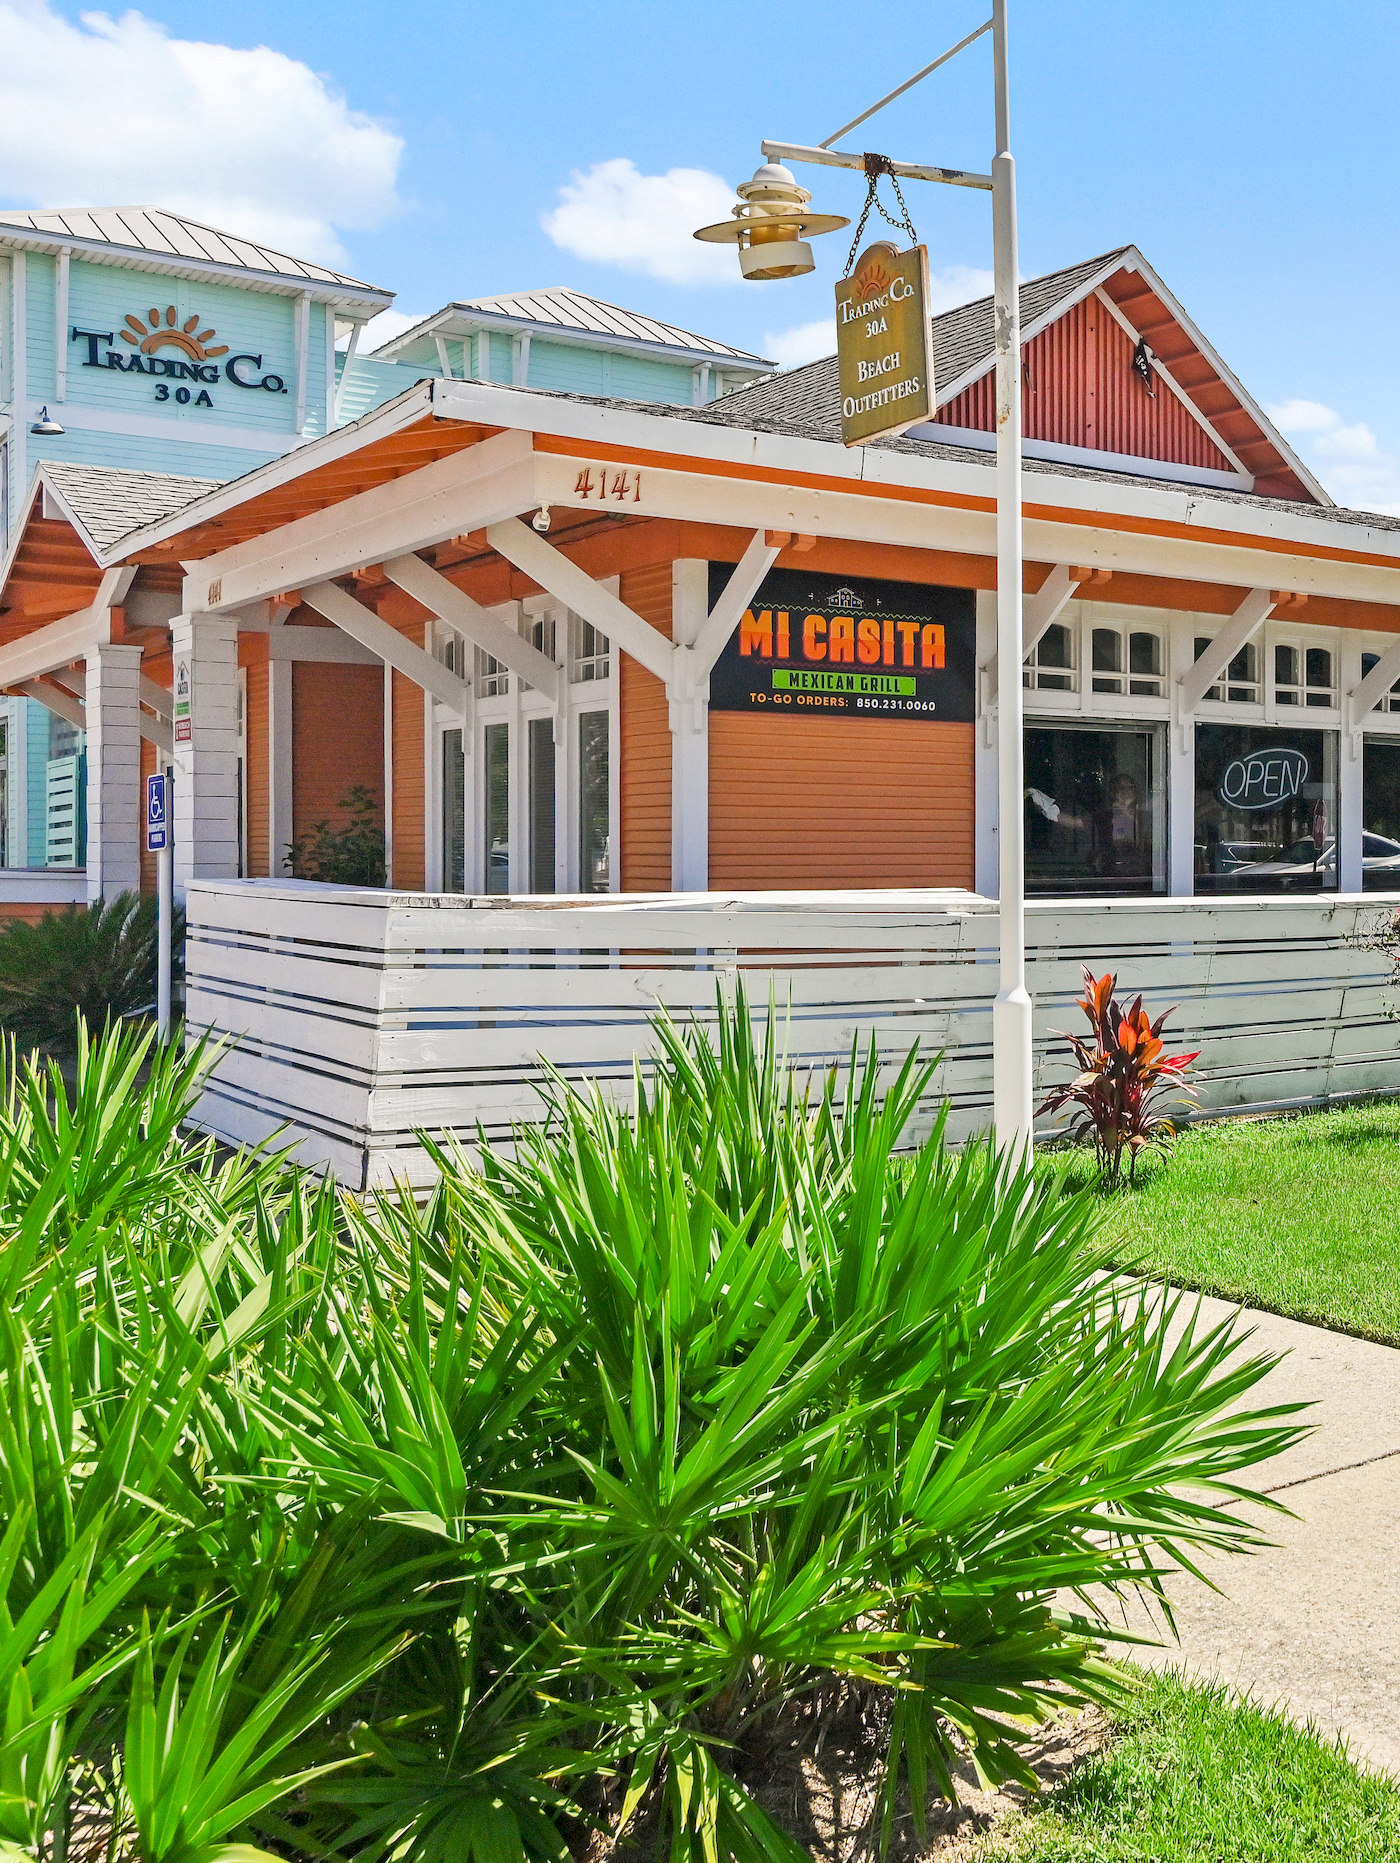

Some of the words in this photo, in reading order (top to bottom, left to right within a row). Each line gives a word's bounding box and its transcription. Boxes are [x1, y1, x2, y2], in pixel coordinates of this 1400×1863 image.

[866, 317, 889, 339] 30A
[857, 352, 901, 383] BEACH
[843, 376, 920, 418] OUTFITTERS
[573, 468, 641, 502] 4141
[739, 609, 790, 659] MI
[803, 614, 946, 669] CASITA
[789, 672, 854, 690] MEXICAN
[860, 676, 901, 693] GRILL
[750, 692, 792, 704] TO-GO
[797, 695, 849, 707] ORDERS:
[857, 698, 936, 712] 850.231.0060
[1224, 760, 1301, 798] OPEN
